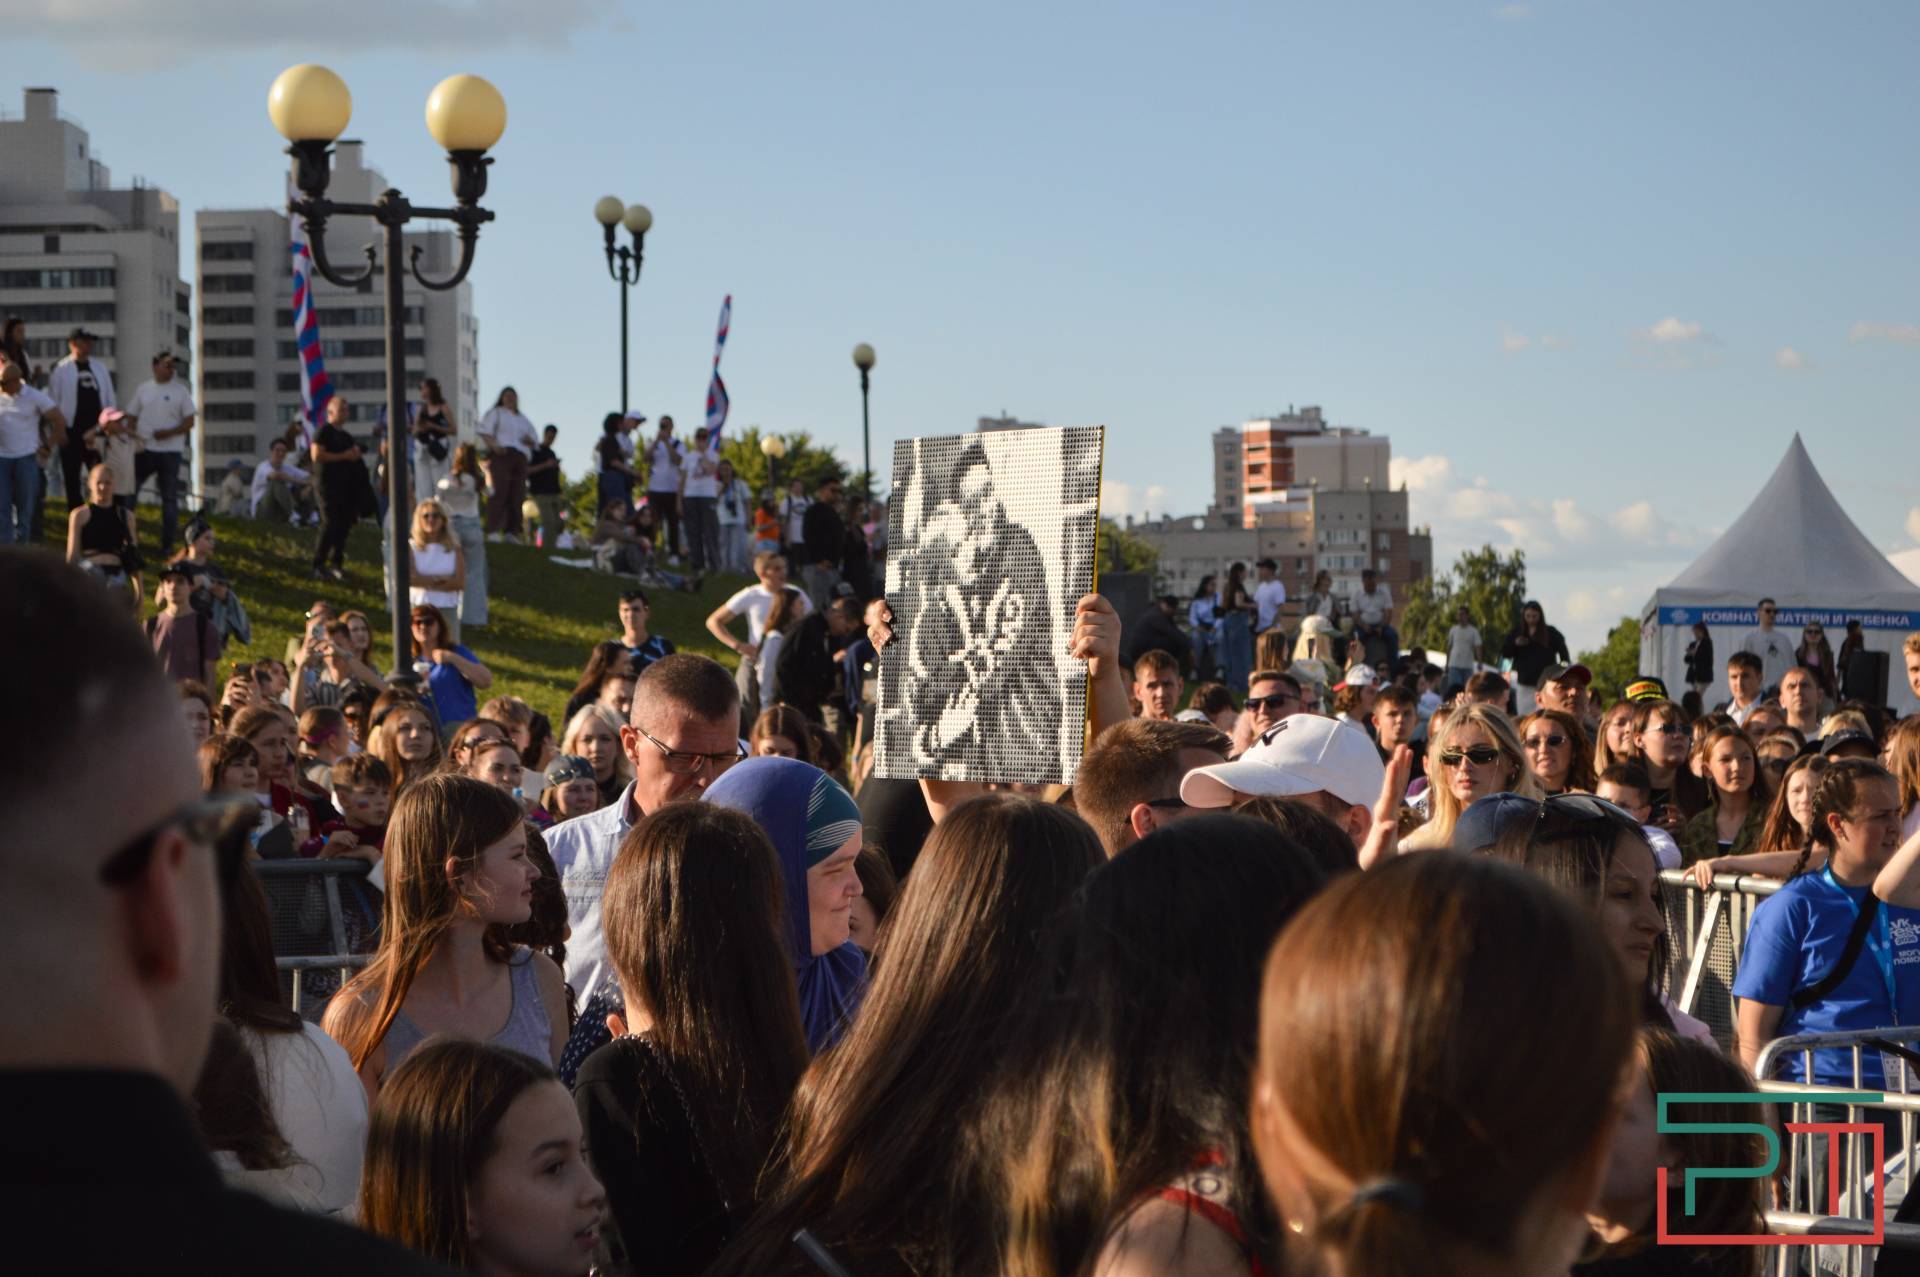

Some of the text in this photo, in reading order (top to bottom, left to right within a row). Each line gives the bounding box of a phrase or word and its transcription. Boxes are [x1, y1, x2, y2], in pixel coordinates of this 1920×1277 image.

[1702, 611, 1759, 623] КОМНАТ
[1775, 613, 1829, 625] МАТЕРИ
[1833, 614, 1842, 625] И
